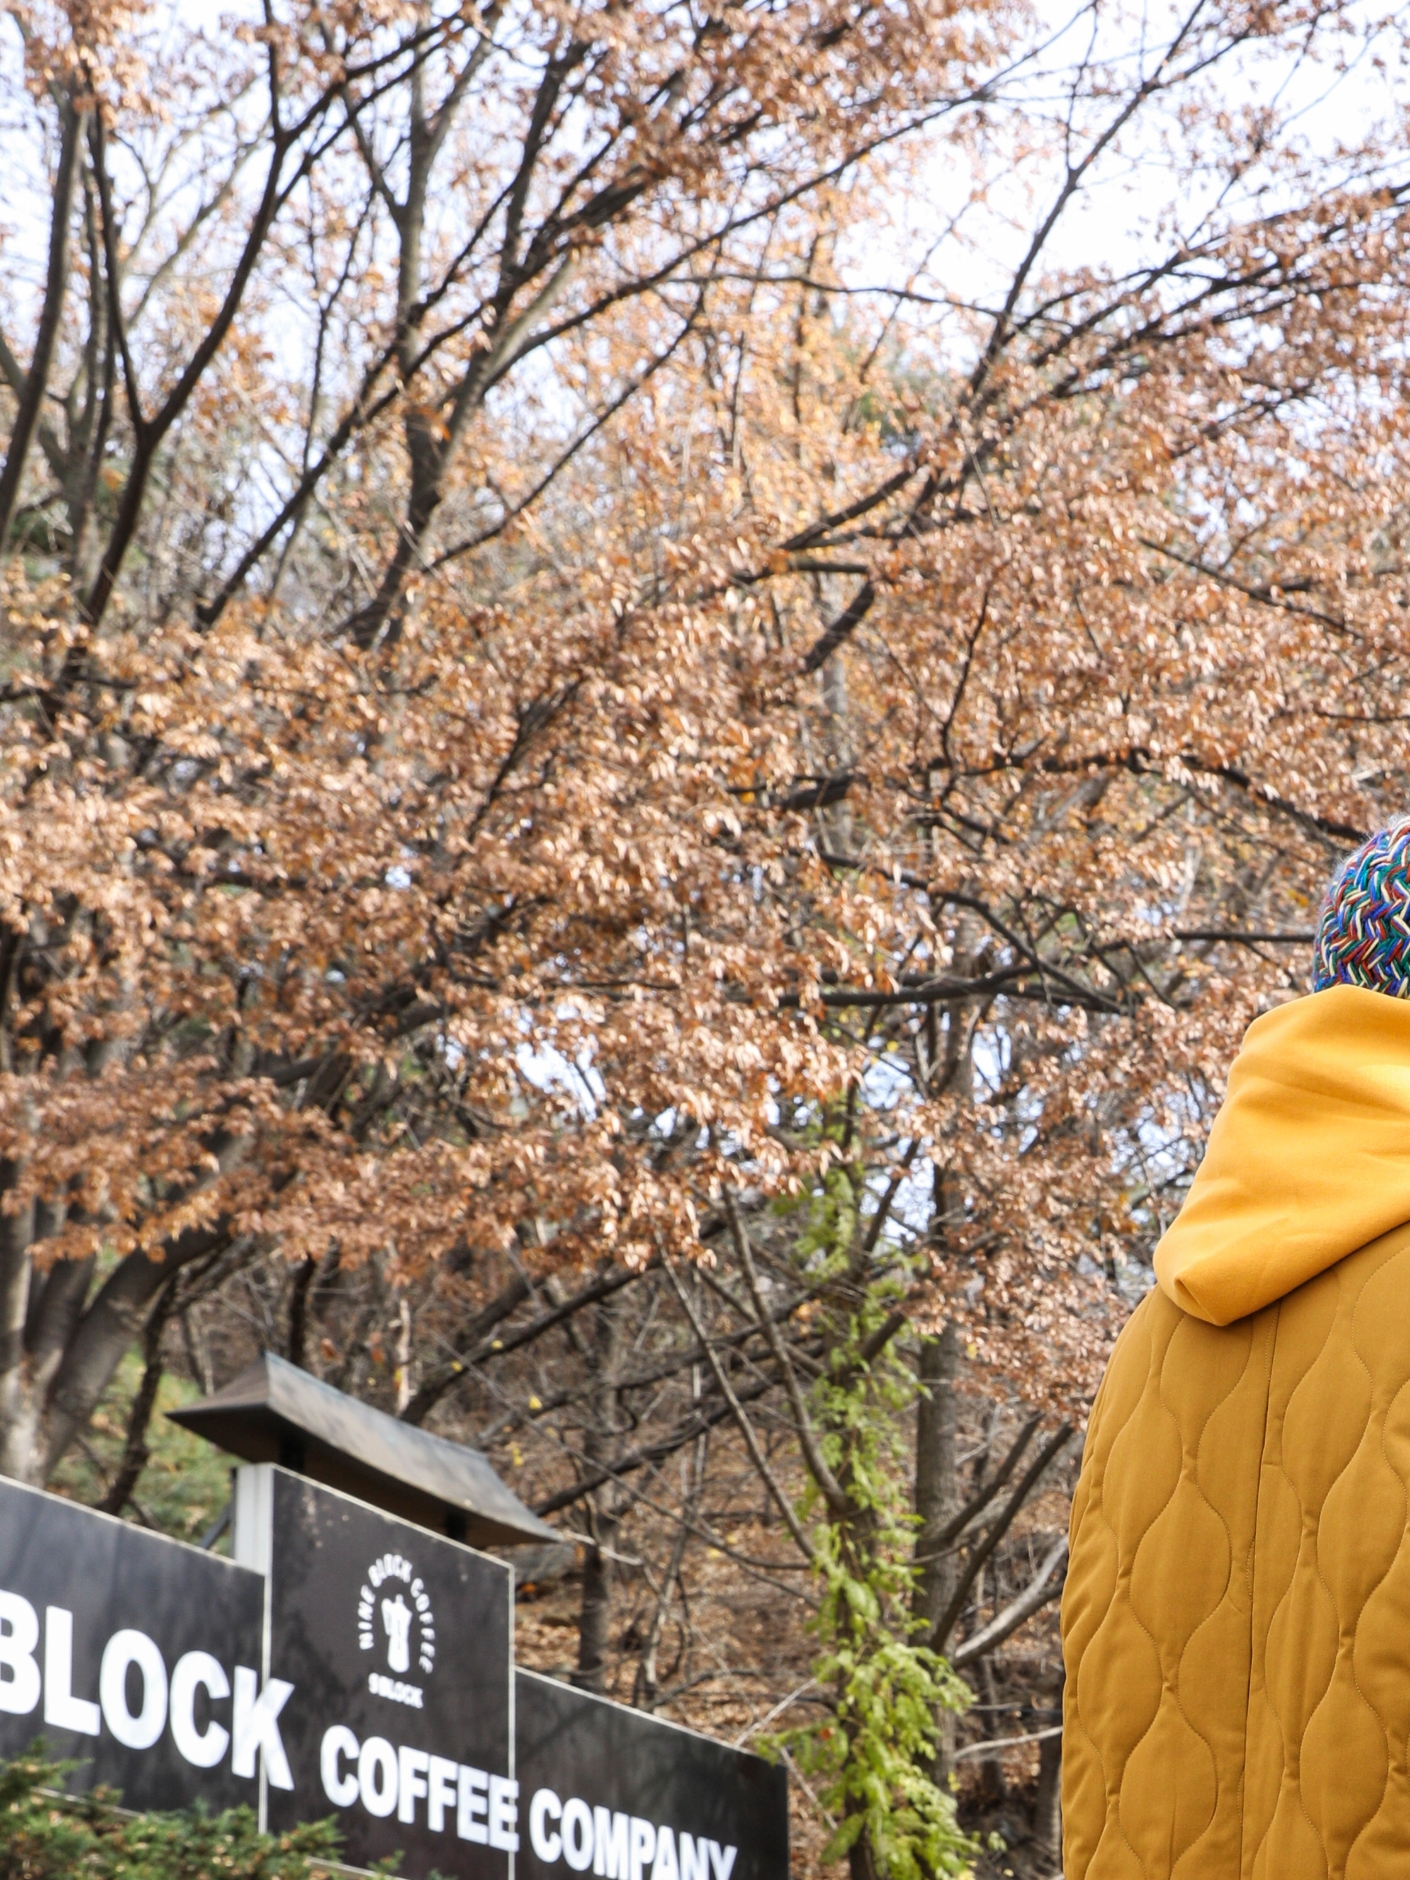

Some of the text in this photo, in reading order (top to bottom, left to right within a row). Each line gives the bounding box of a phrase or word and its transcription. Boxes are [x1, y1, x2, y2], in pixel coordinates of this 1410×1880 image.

[368, 1553, 413, 1588] BLOCK
[410, 1577, 436, 1674] COFFEE
[0, 1588, 295, 1791] BLOCK
[320, 1724, 519, 1852] COFFEE
